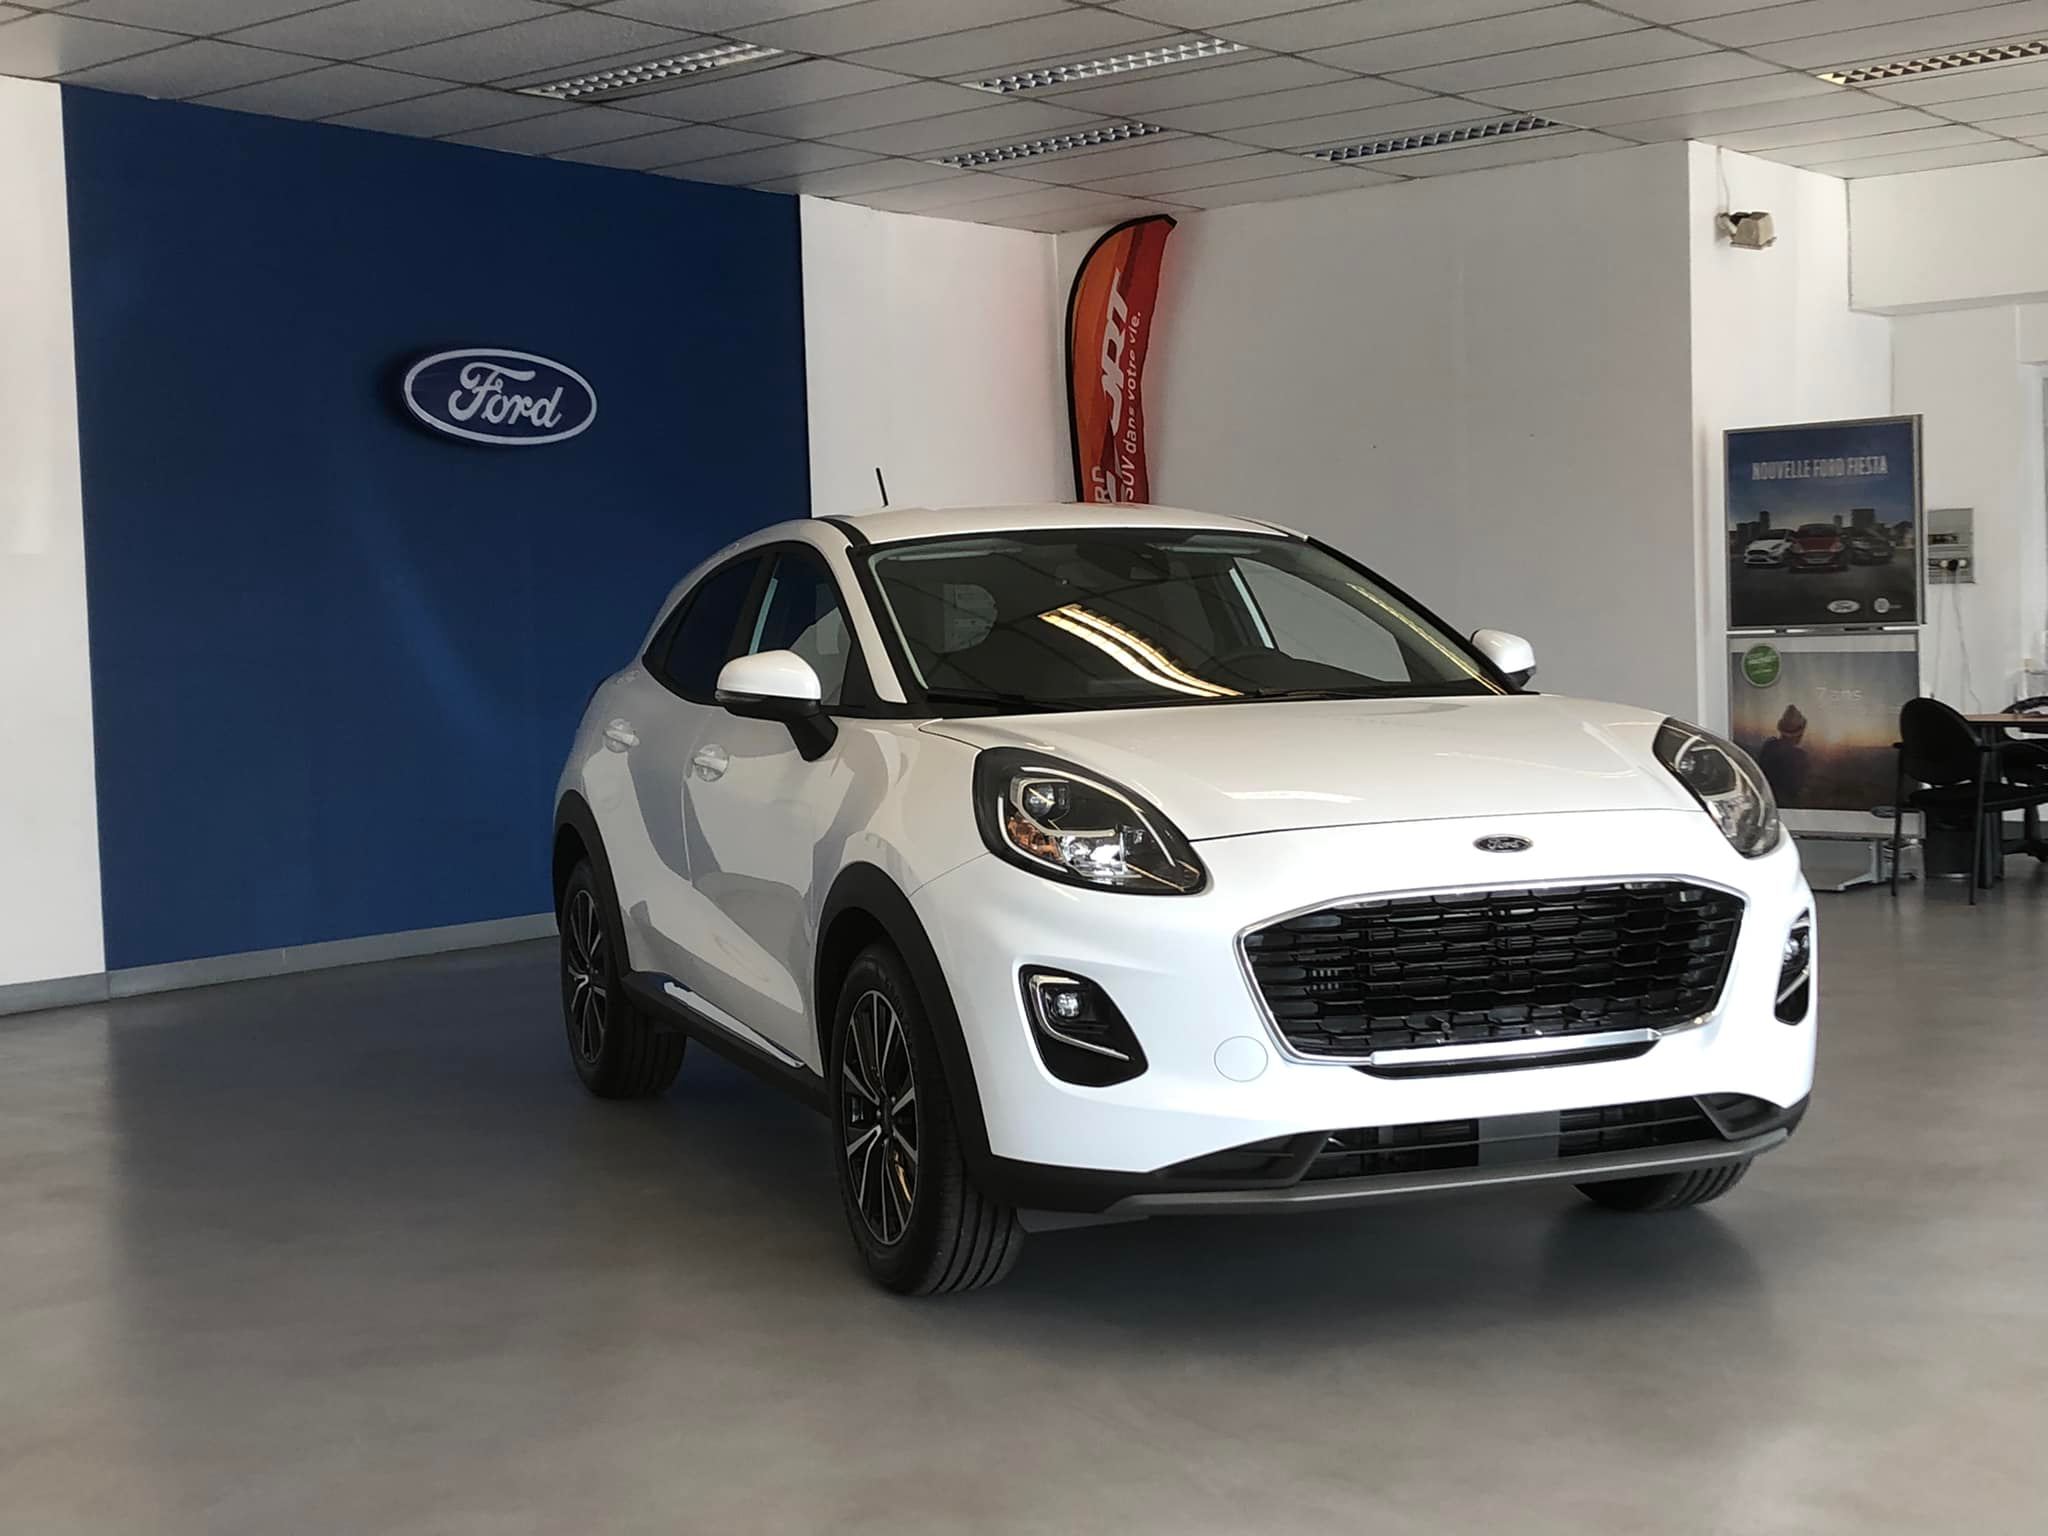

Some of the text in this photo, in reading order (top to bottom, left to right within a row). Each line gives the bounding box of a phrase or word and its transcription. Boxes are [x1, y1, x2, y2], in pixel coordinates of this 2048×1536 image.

[448, 362, 564, 428] Ford
[1752, 460, 1810, 480] NOUVELLE
[1847, 456, 1888, 475] FIESTA
